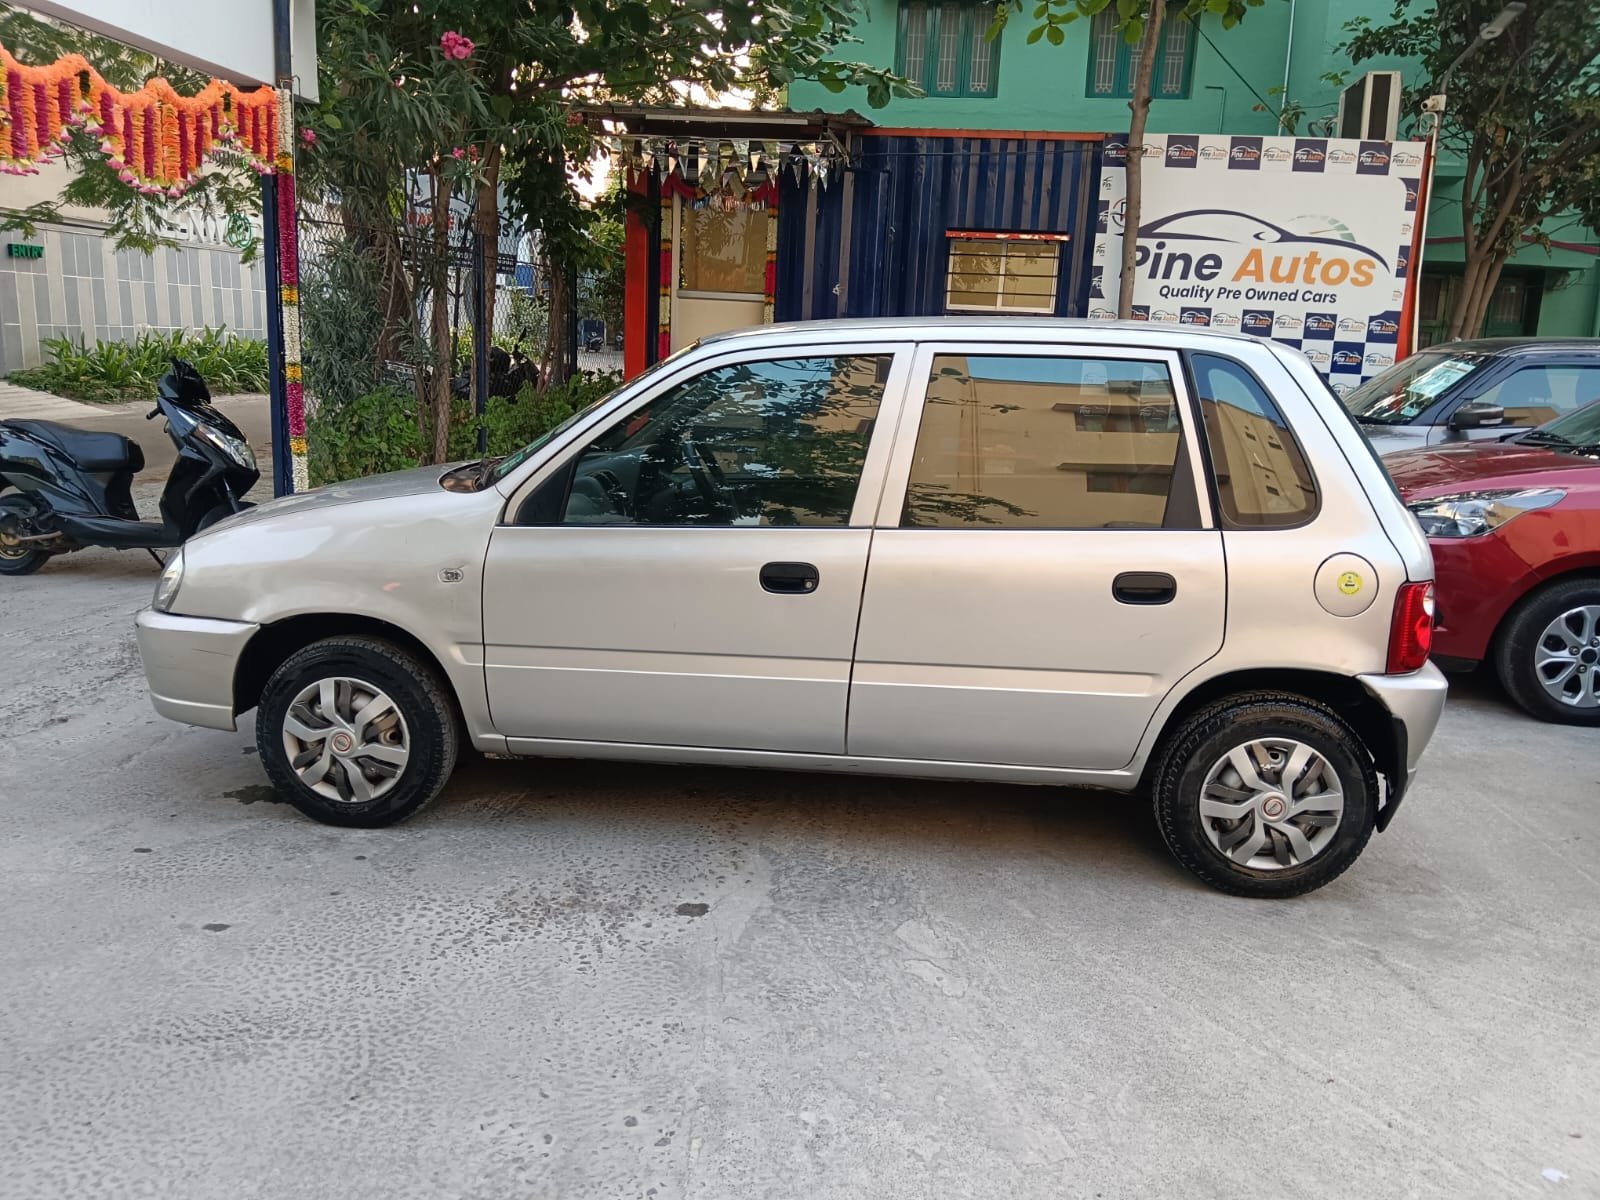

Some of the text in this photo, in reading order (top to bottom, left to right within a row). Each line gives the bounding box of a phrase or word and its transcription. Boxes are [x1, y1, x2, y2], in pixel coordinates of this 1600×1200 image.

[11, 243, 44, 258] ENTRY
[1231, 247, 1377, 288] Autos
[1159, 285, 1337, 304] Quality Pre Owned Cars
